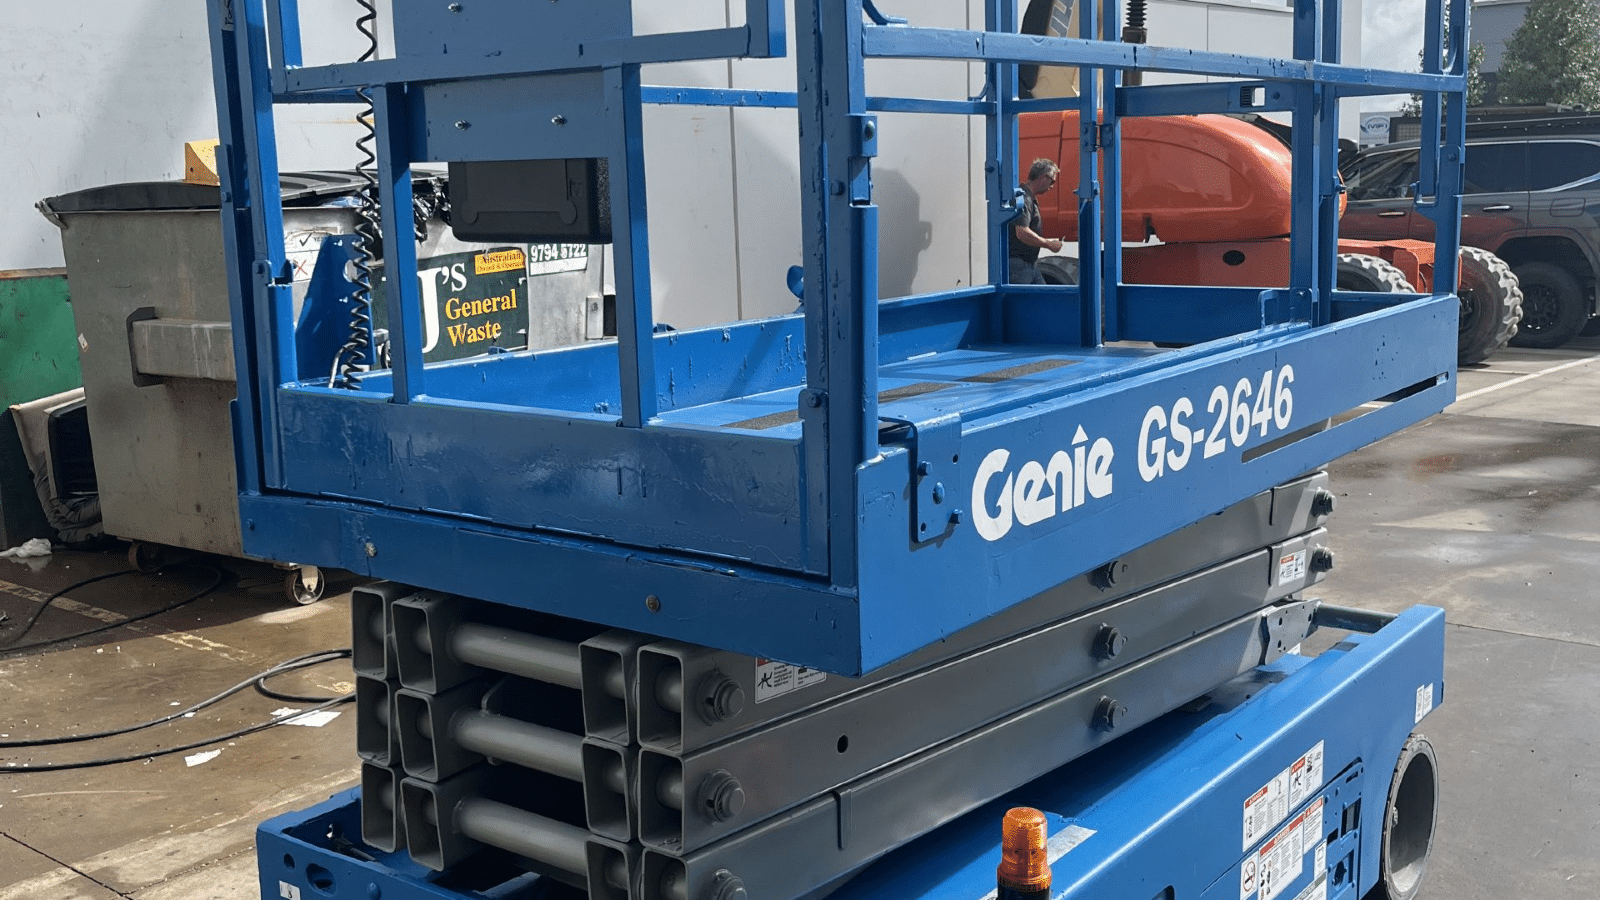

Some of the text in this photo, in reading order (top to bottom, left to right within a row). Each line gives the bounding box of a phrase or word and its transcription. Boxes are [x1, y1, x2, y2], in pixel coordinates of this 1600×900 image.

[530, 244, 558, 262] 9794
[445, 288, 517, 320] General
[446, 320, 502, 347] Waste
[971, 364, 1295, 541] Genie GS-2646
